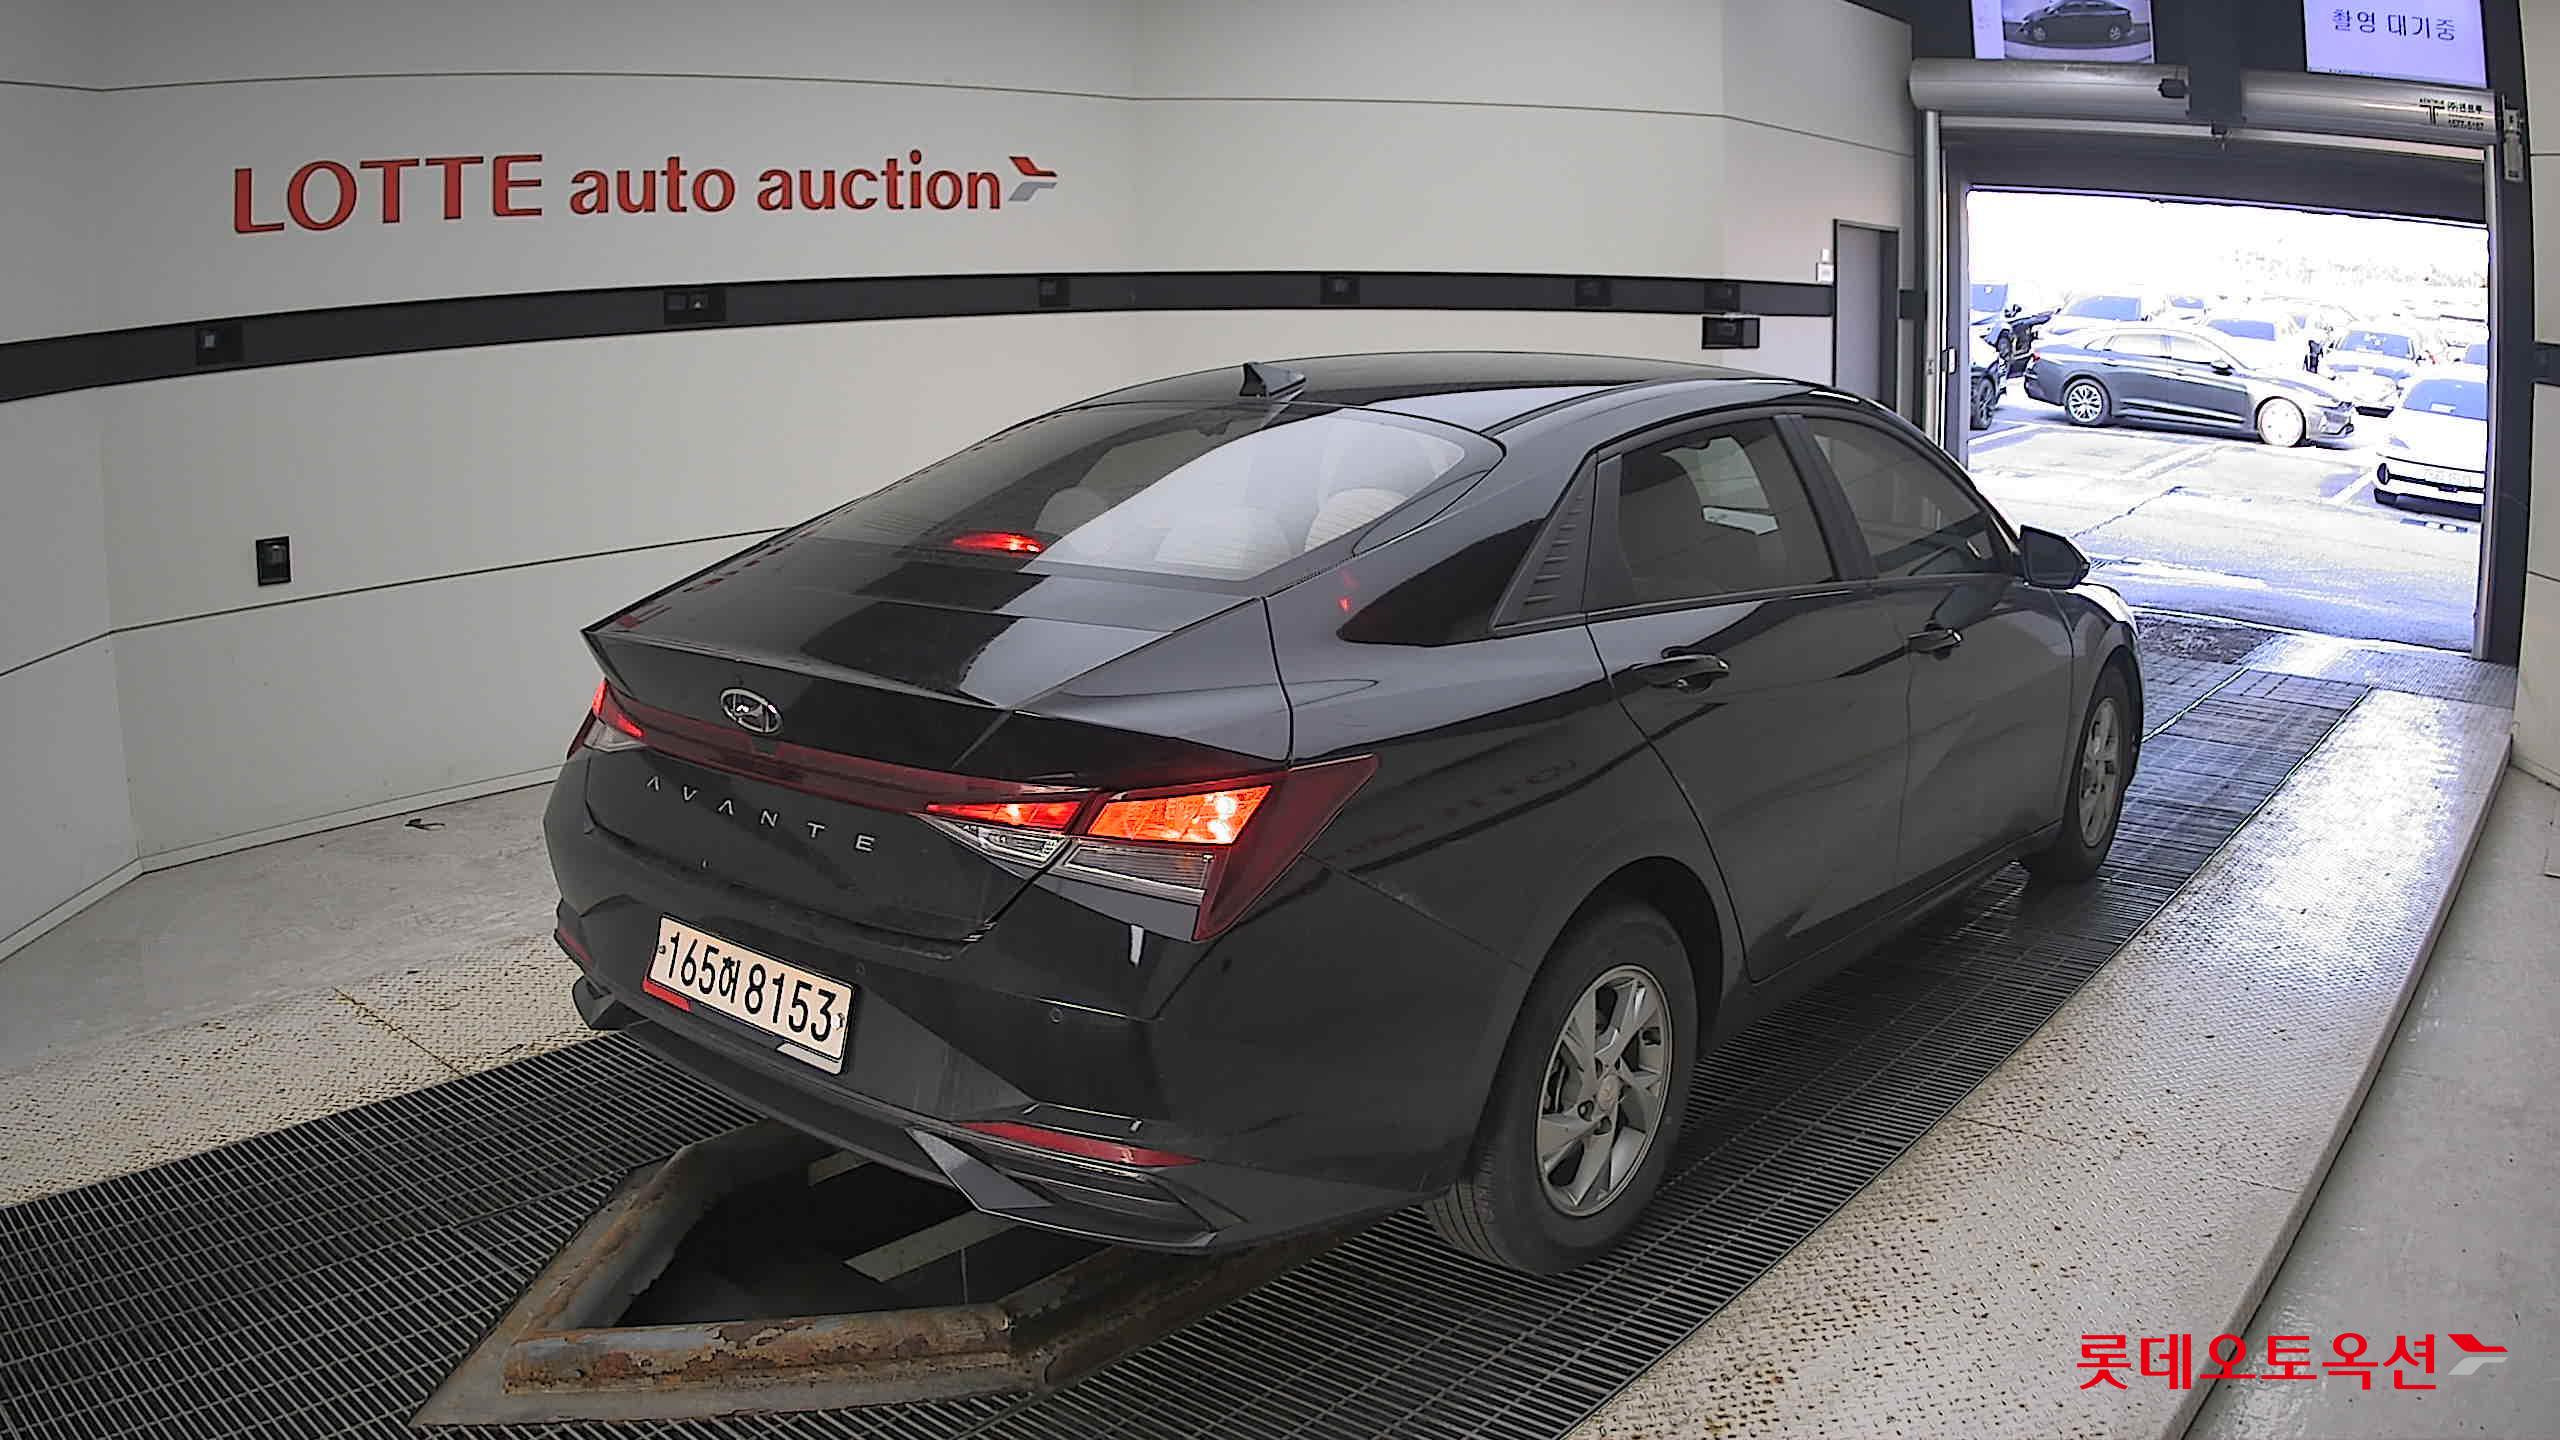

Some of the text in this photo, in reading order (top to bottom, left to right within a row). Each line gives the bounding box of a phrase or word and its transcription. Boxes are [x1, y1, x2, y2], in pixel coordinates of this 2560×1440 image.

[2333, 8, 2376, 34] 촬영
[234, 150, 1002, 233] LOTTE auto auction
[647, 776, 876, 852] AVANTE
